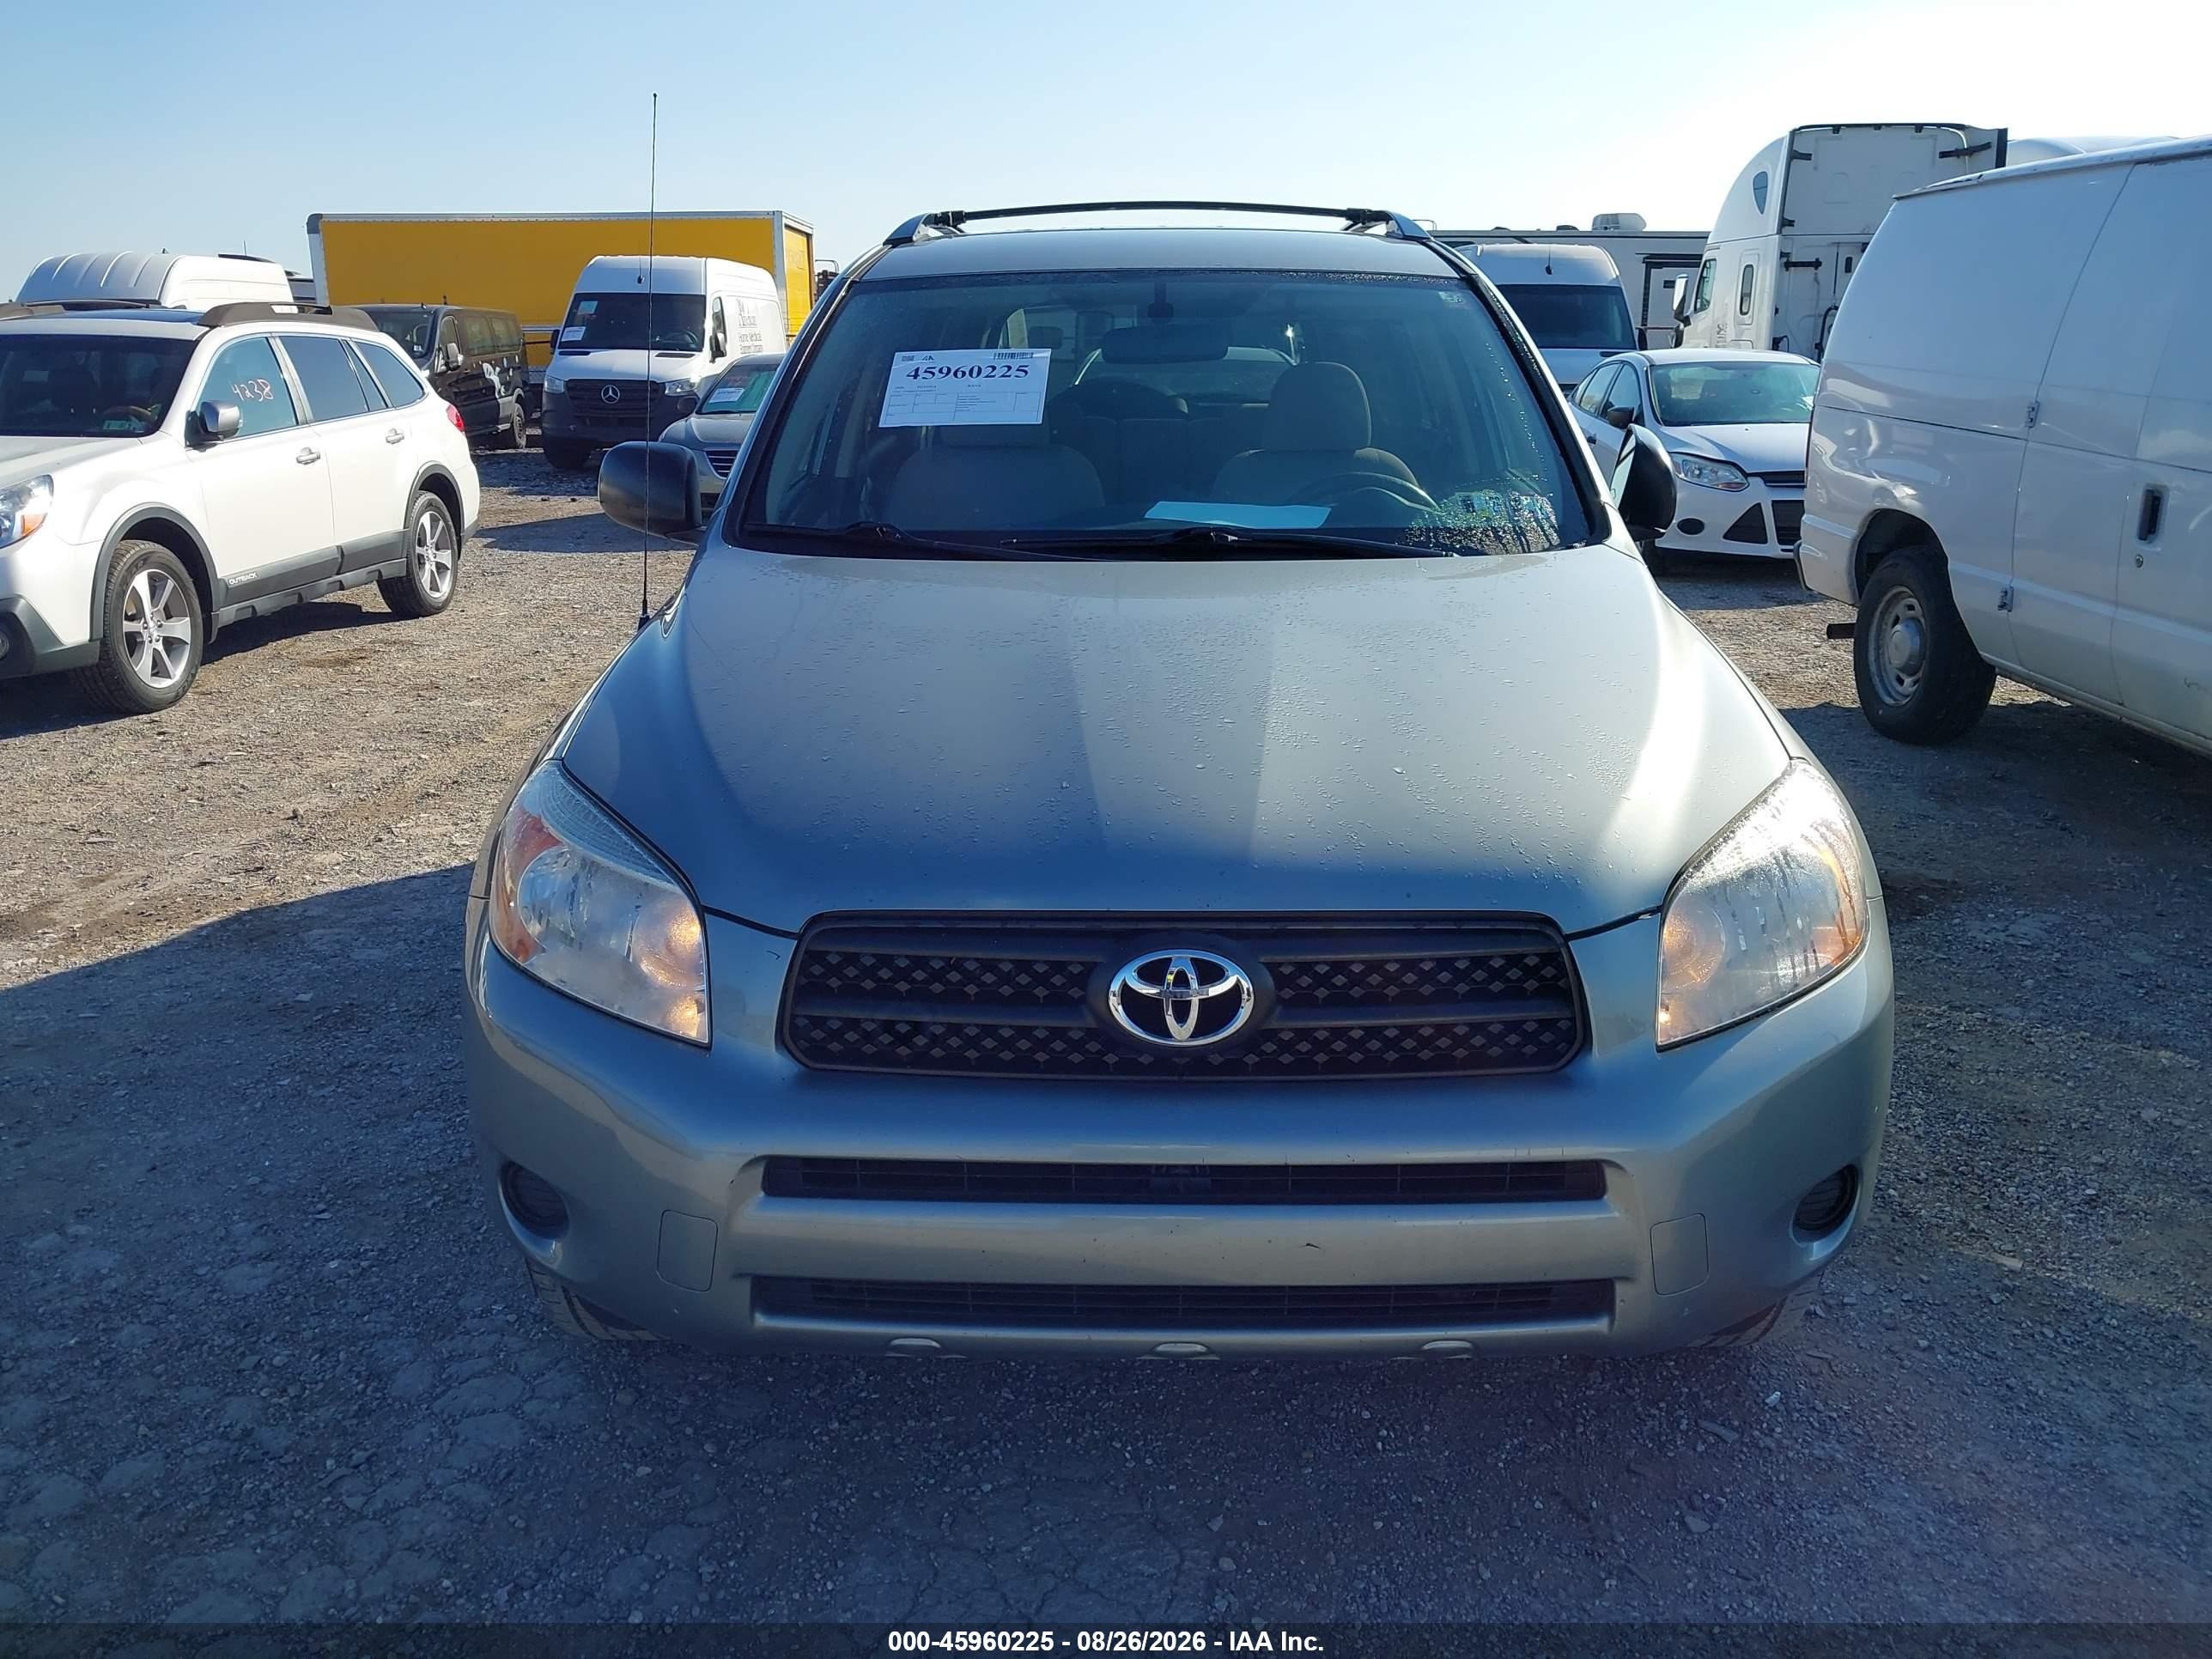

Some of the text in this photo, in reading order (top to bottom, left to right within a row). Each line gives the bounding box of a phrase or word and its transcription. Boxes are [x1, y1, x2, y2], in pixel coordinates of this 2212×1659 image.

[906, 364, 1030, 380] 45960225
[231, 378, 274, 402] 4238
[228, 571, 258, 585] OUTBACK
